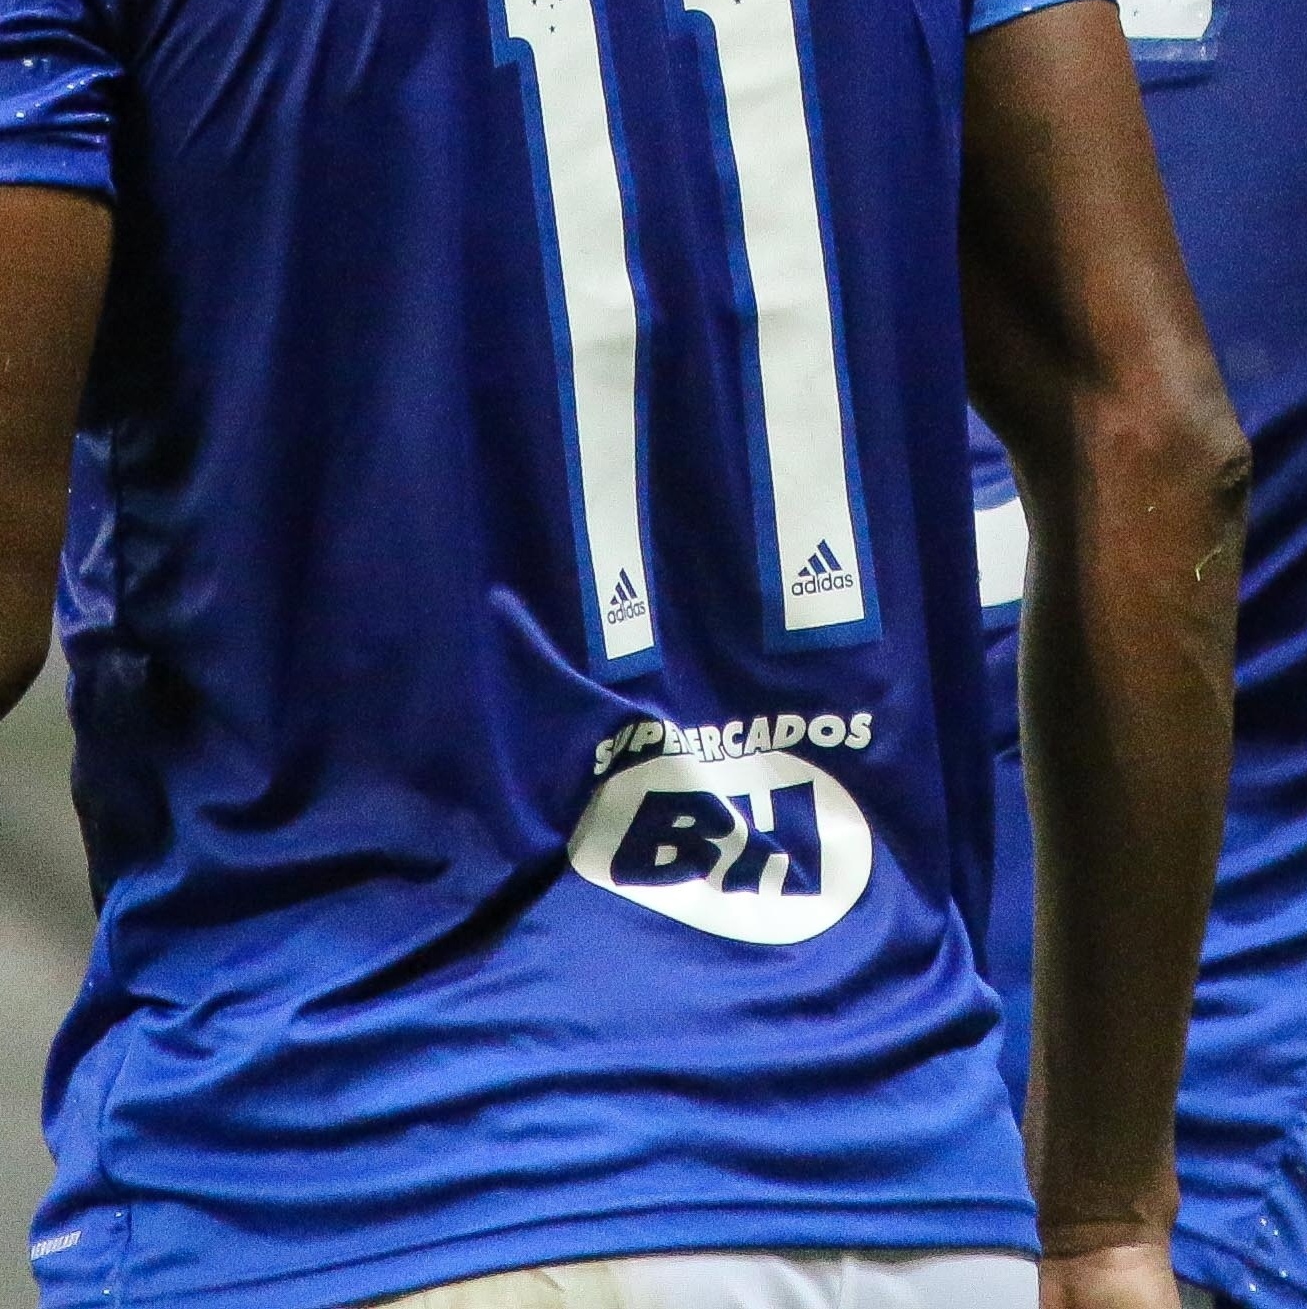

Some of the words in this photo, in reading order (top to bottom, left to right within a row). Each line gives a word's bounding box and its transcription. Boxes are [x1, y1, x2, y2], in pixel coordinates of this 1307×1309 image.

[791, 571, 854, 597] adidas
[606, 599, 647, 626] adidas
[609, 780, 823, 897] BH
